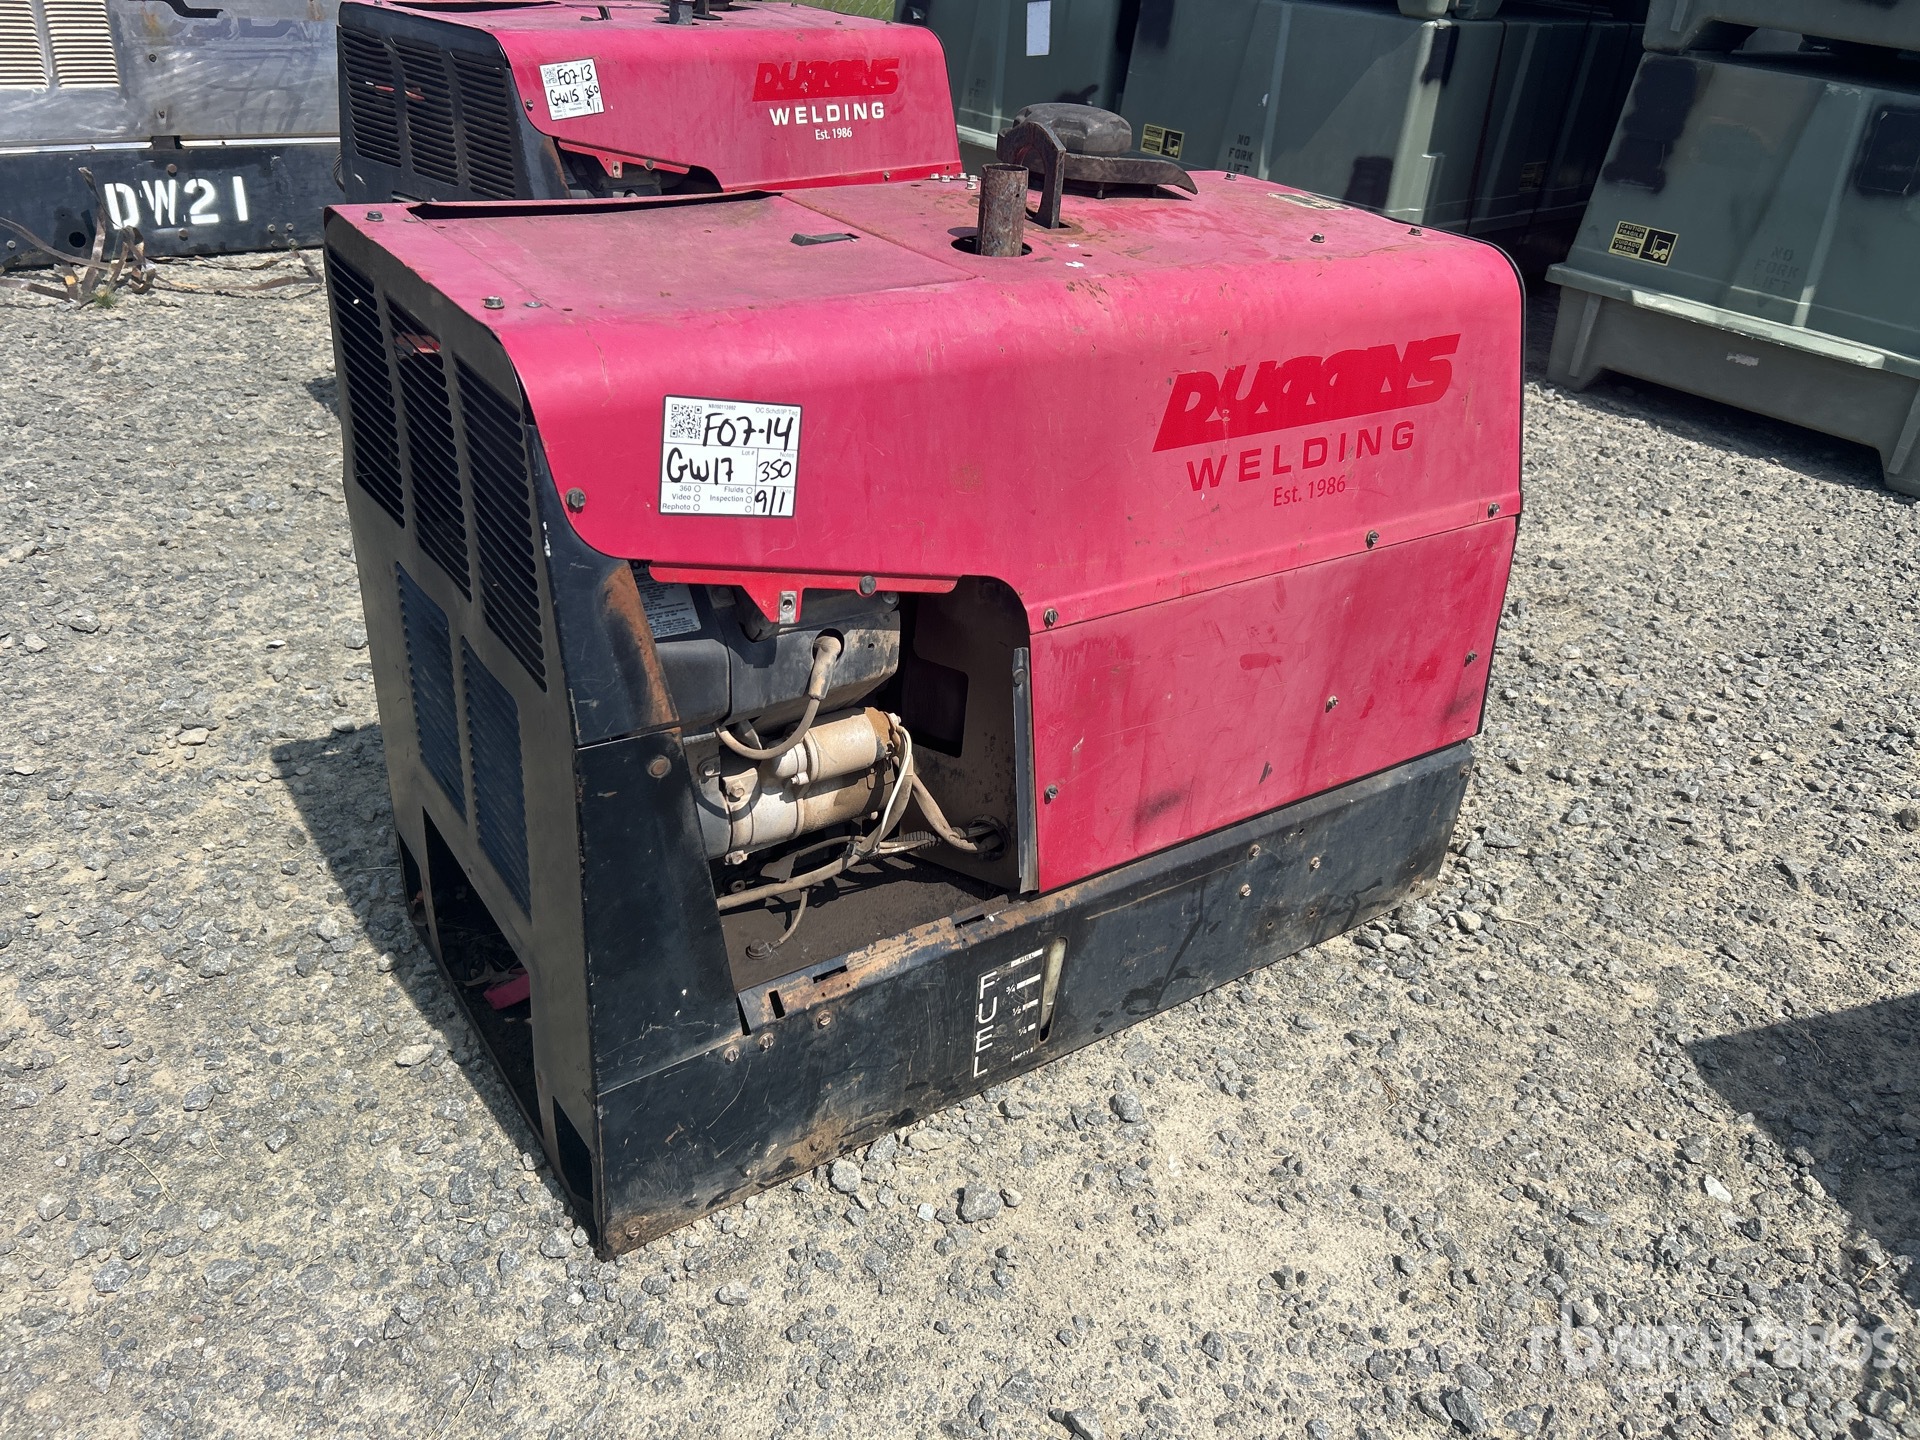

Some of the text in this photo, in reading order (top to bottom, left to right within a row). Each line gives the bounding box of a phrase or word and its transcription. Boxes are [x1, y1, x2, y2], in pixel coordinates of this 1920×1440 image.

[769, 102, 885, 126] WELDING
[815, 127, 853, 141] Est. 1986
[1237, 133, 1251, 146] NO
[1228, 147, 1254, 162] FORK
[104, 176, 249, 230] DW21
[1619, 229, 1643, 238] FRAGILE
[1621, 223, 1645, 232] CAUTION
[1771, 246, 1794, 261] NO
[1754, 258, 1800, 278] FORK
[1186, 420, 1416, 491] WELDING
[666, 447, 734, 485] GW17
[758, 459, 792, 483] 350
[671, 493, 691, 501] Video
[724, 486, 744, 494] Fluids
[1273, 474, 1346, 507] Est. 1986
[709, 495, 744, 503] Inspection
[662, 503, 691, 511] Rephoto
